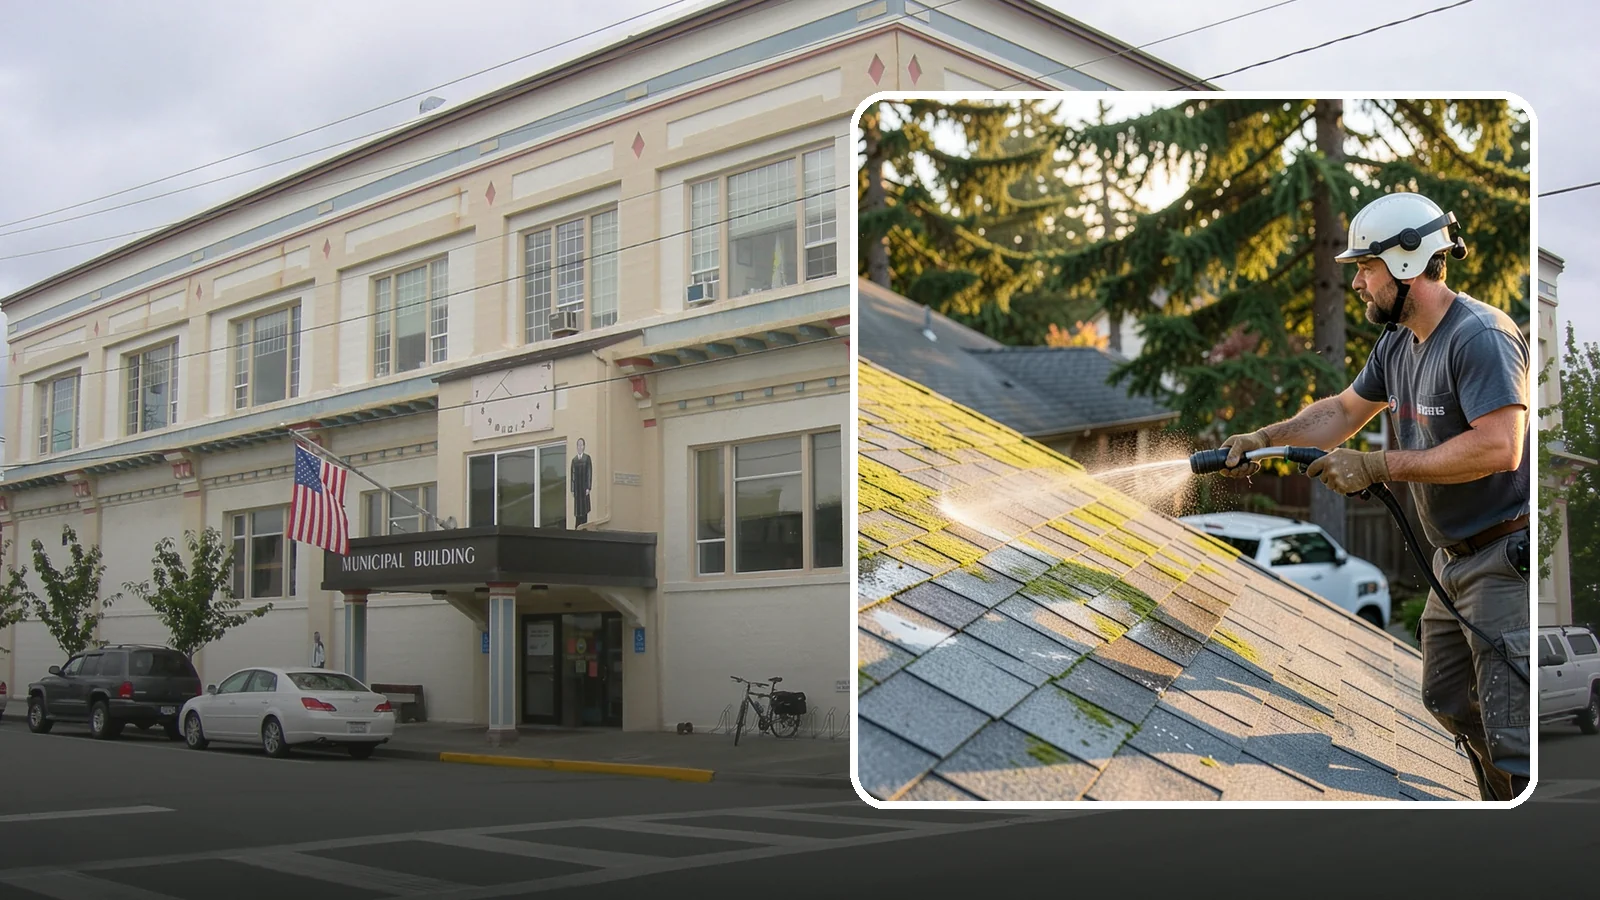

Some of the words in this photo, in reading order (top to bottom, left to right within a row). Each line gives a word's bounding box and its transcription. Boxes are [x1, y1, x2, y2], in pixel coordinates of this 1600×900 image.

[494, 423, 500, 432] 10
[521, 420, 525, 428] 2
[507, 425, 513, 433] 12
[342, 552, 405, 572] MUNICIPAL
[414, 546, 475, 567] BUILDING
